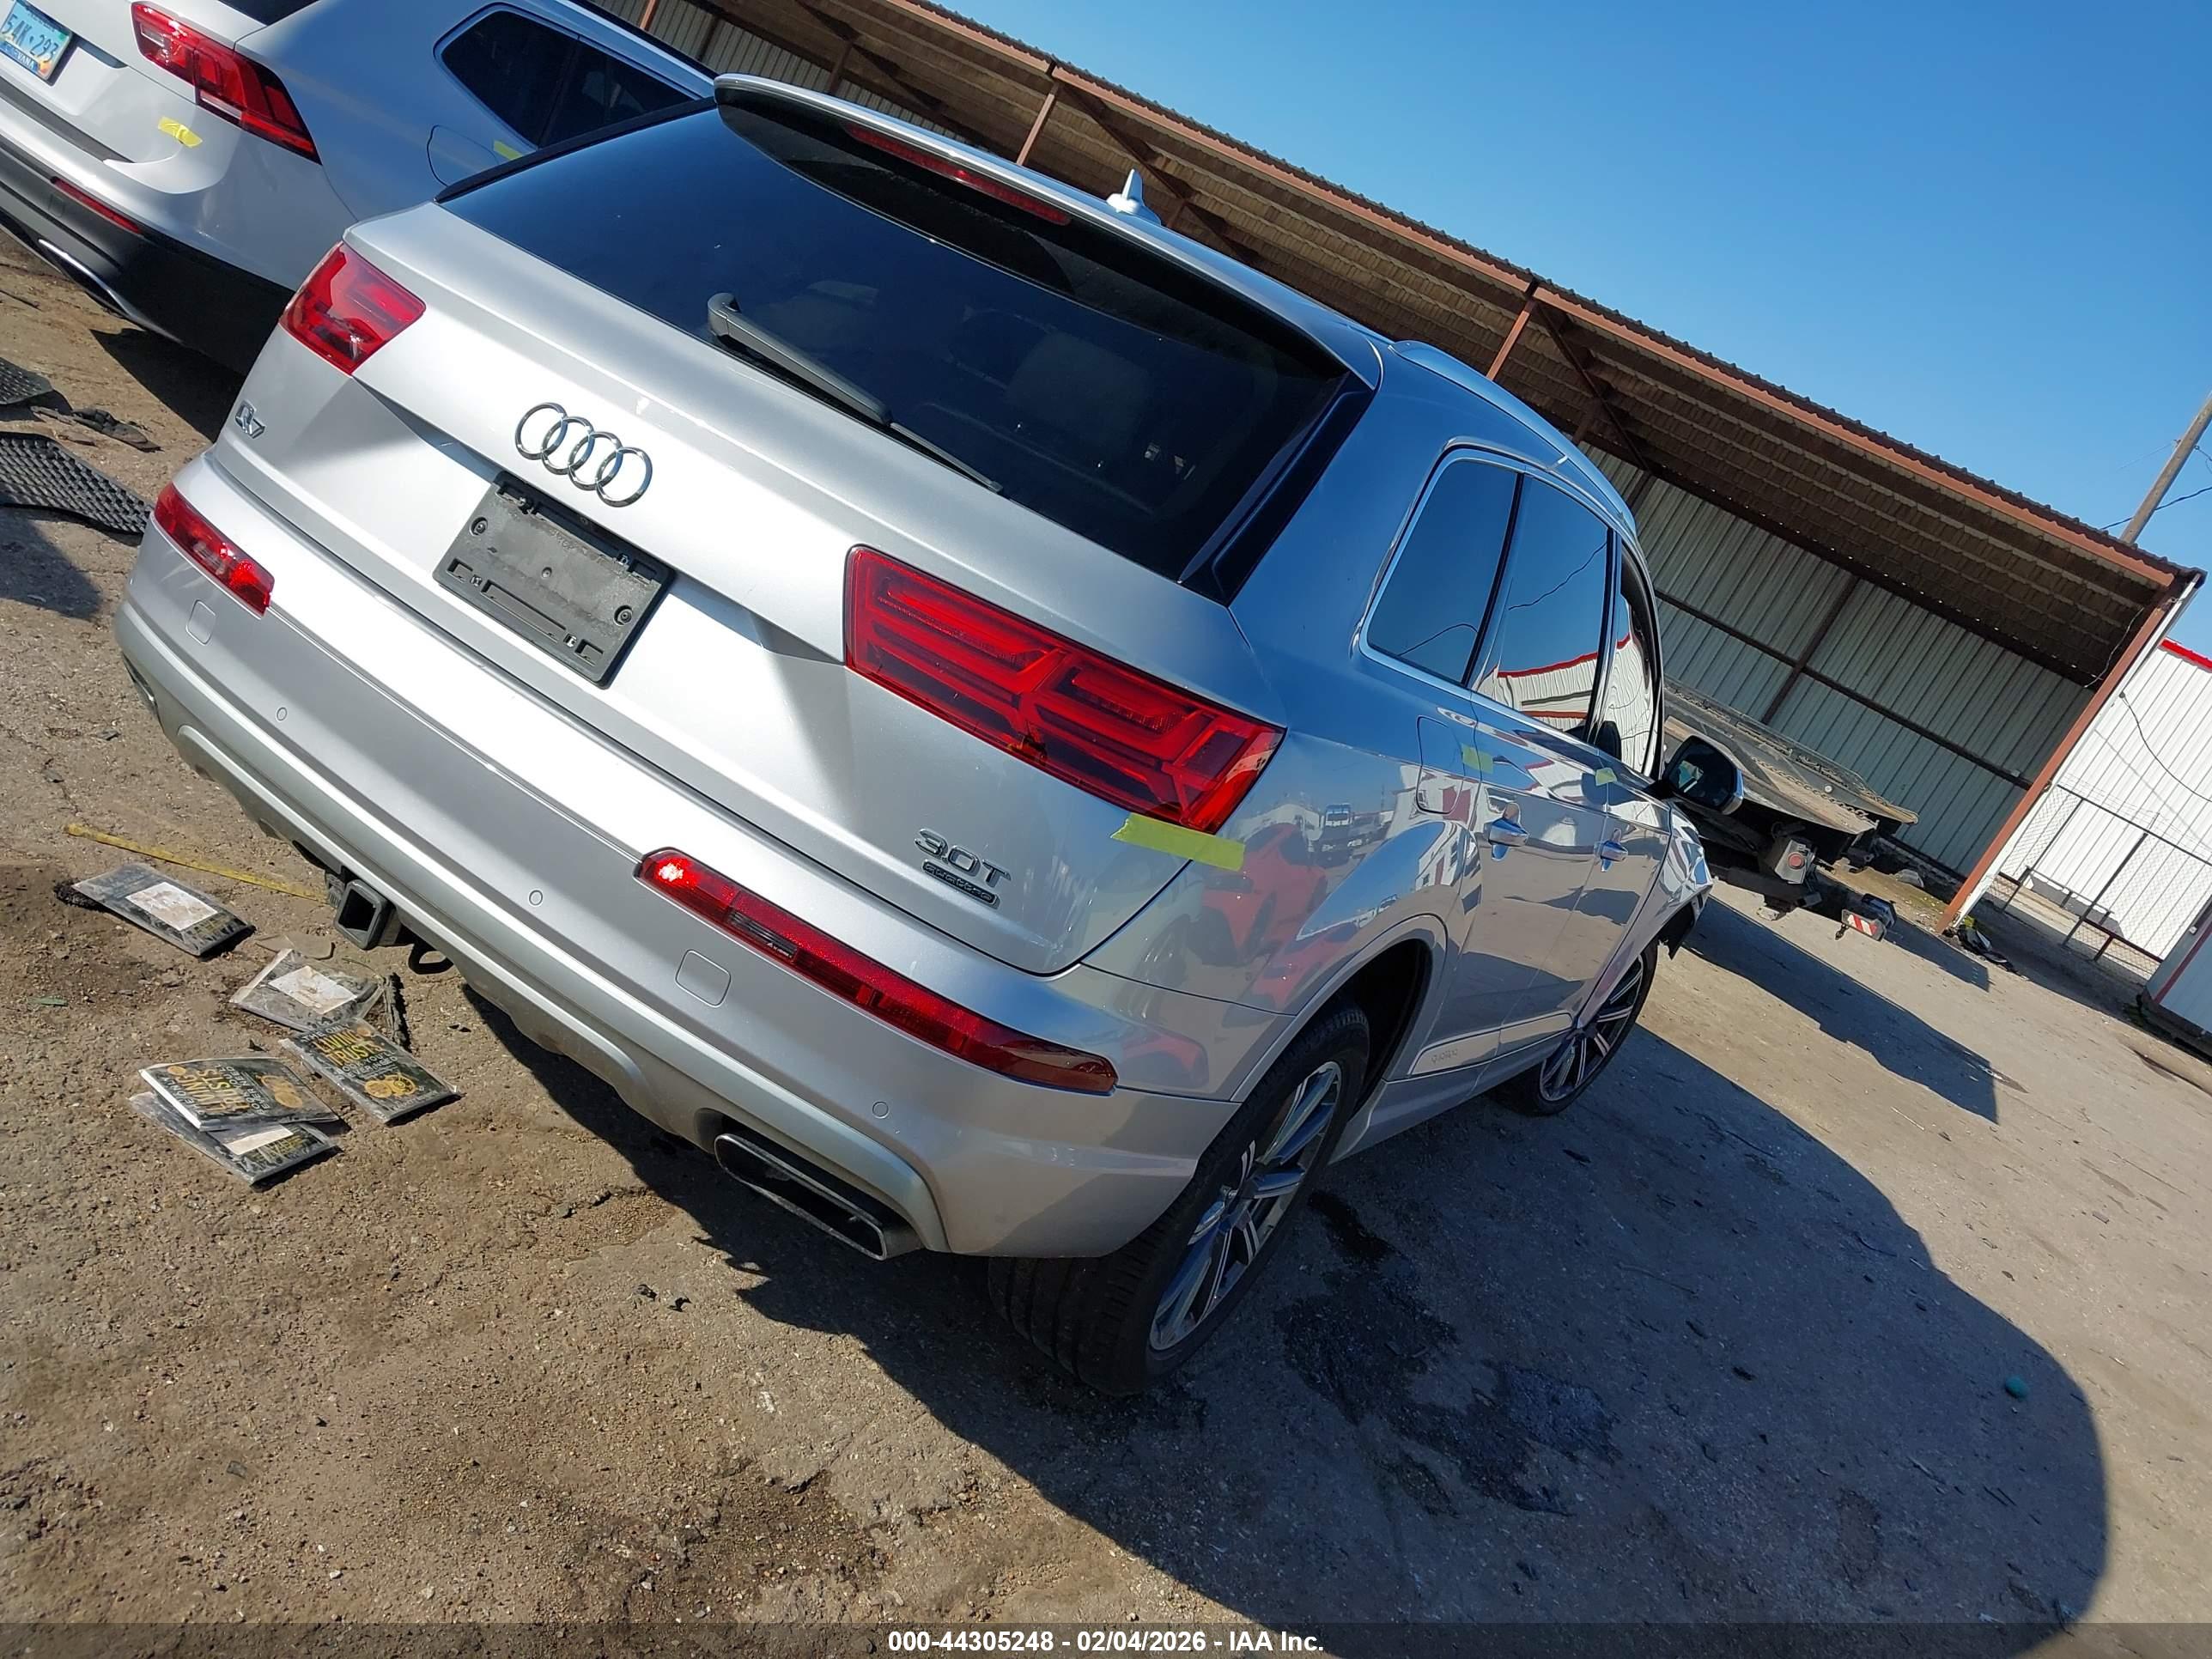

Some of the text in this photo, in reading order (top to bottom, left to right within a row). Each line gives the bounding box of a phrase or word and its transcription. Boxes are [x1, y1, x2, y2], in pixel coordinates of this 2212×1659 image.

[311, 1030, 363, 1053] LIVING
[323, 1040, 385, 1067] TRUSTS
[227, 1066, 251, 1086] NEED
[175, 1074, 227, 1110] LIVING
[197, 1069, 251, 1110] TRUSTS
[248, 1088, 270, 1109] EVER
